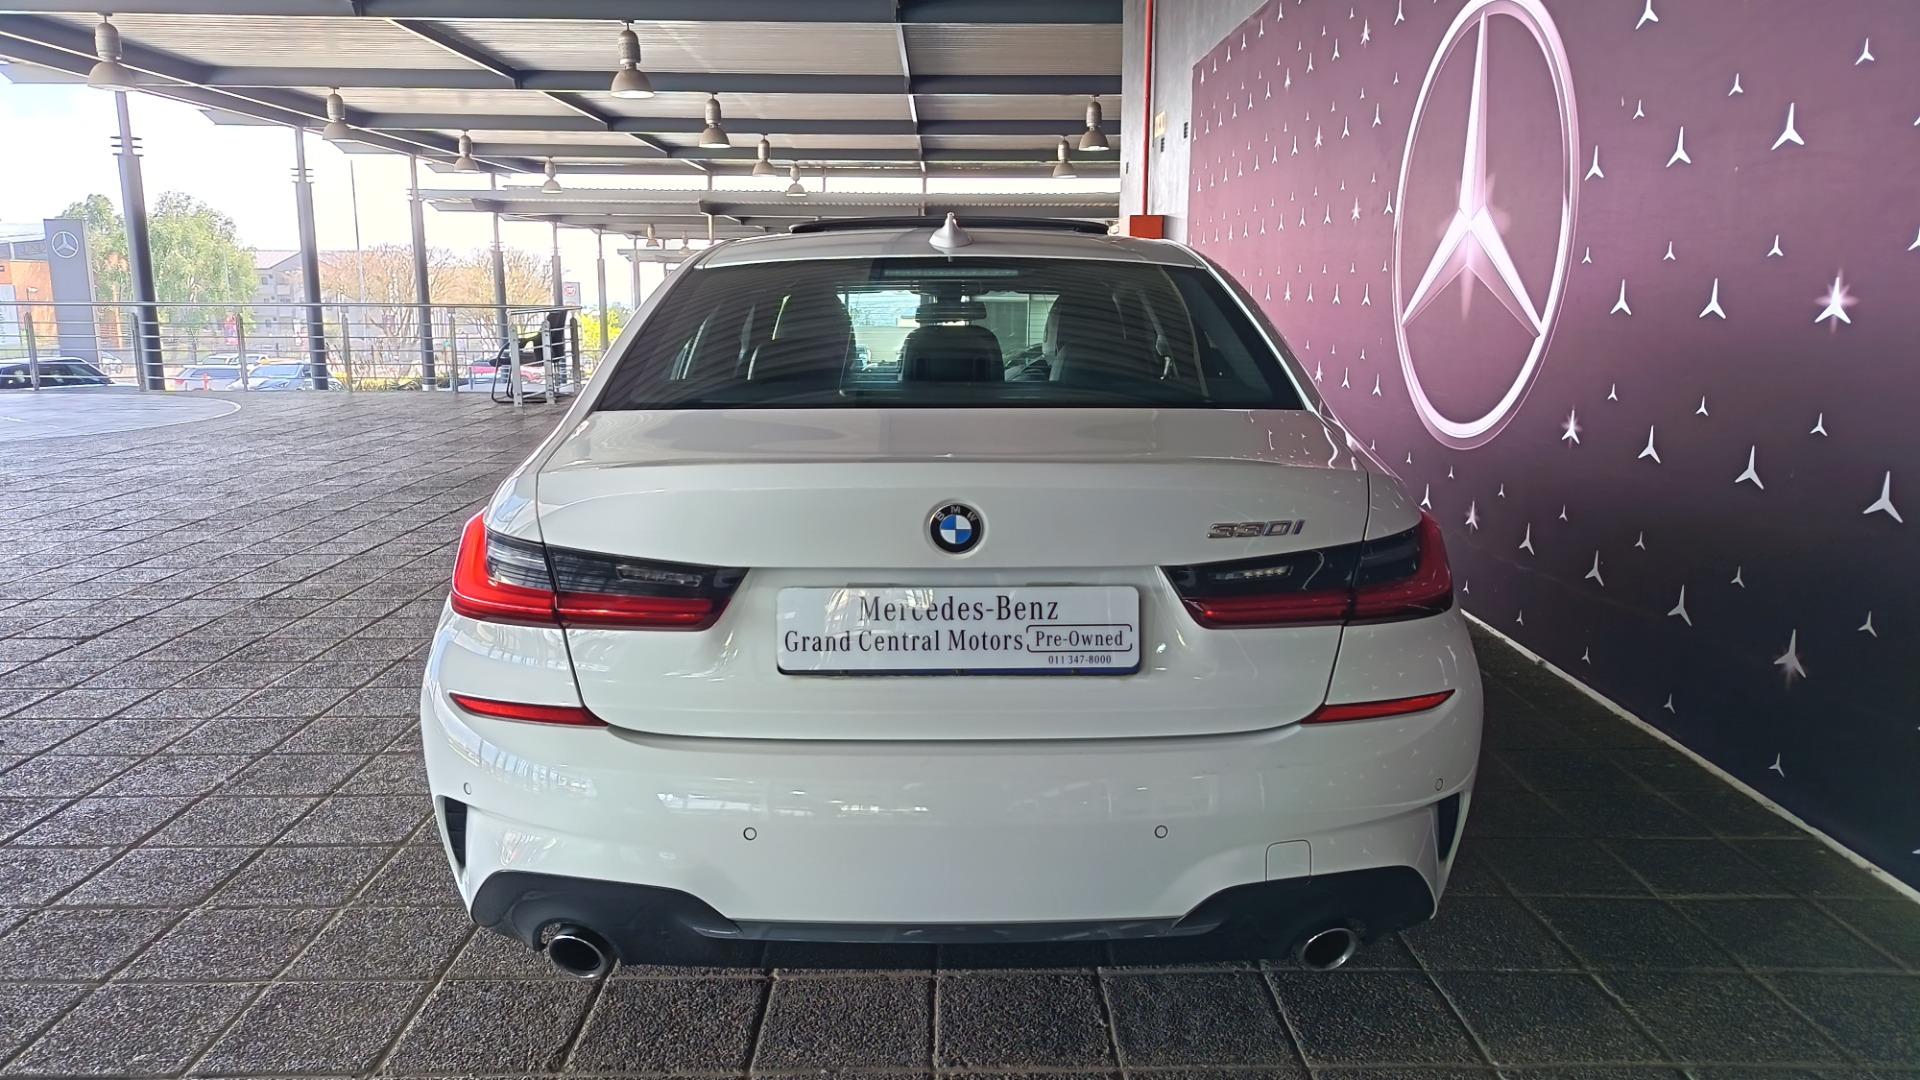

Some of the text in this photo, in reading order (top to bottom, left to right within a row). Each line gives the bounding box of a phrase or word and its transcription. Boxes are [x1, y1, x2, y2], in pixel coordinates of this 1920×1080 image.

[935, 505, 977, 521] BMW
[859, 595, 1059, 621] Mercedes-Benz
[784, 629, 1024, 652] Grand Central Motors
[1035, 630, 1124, 647] Pre-Owned
[1048, 655, 1112, 665] 011 347-8000
